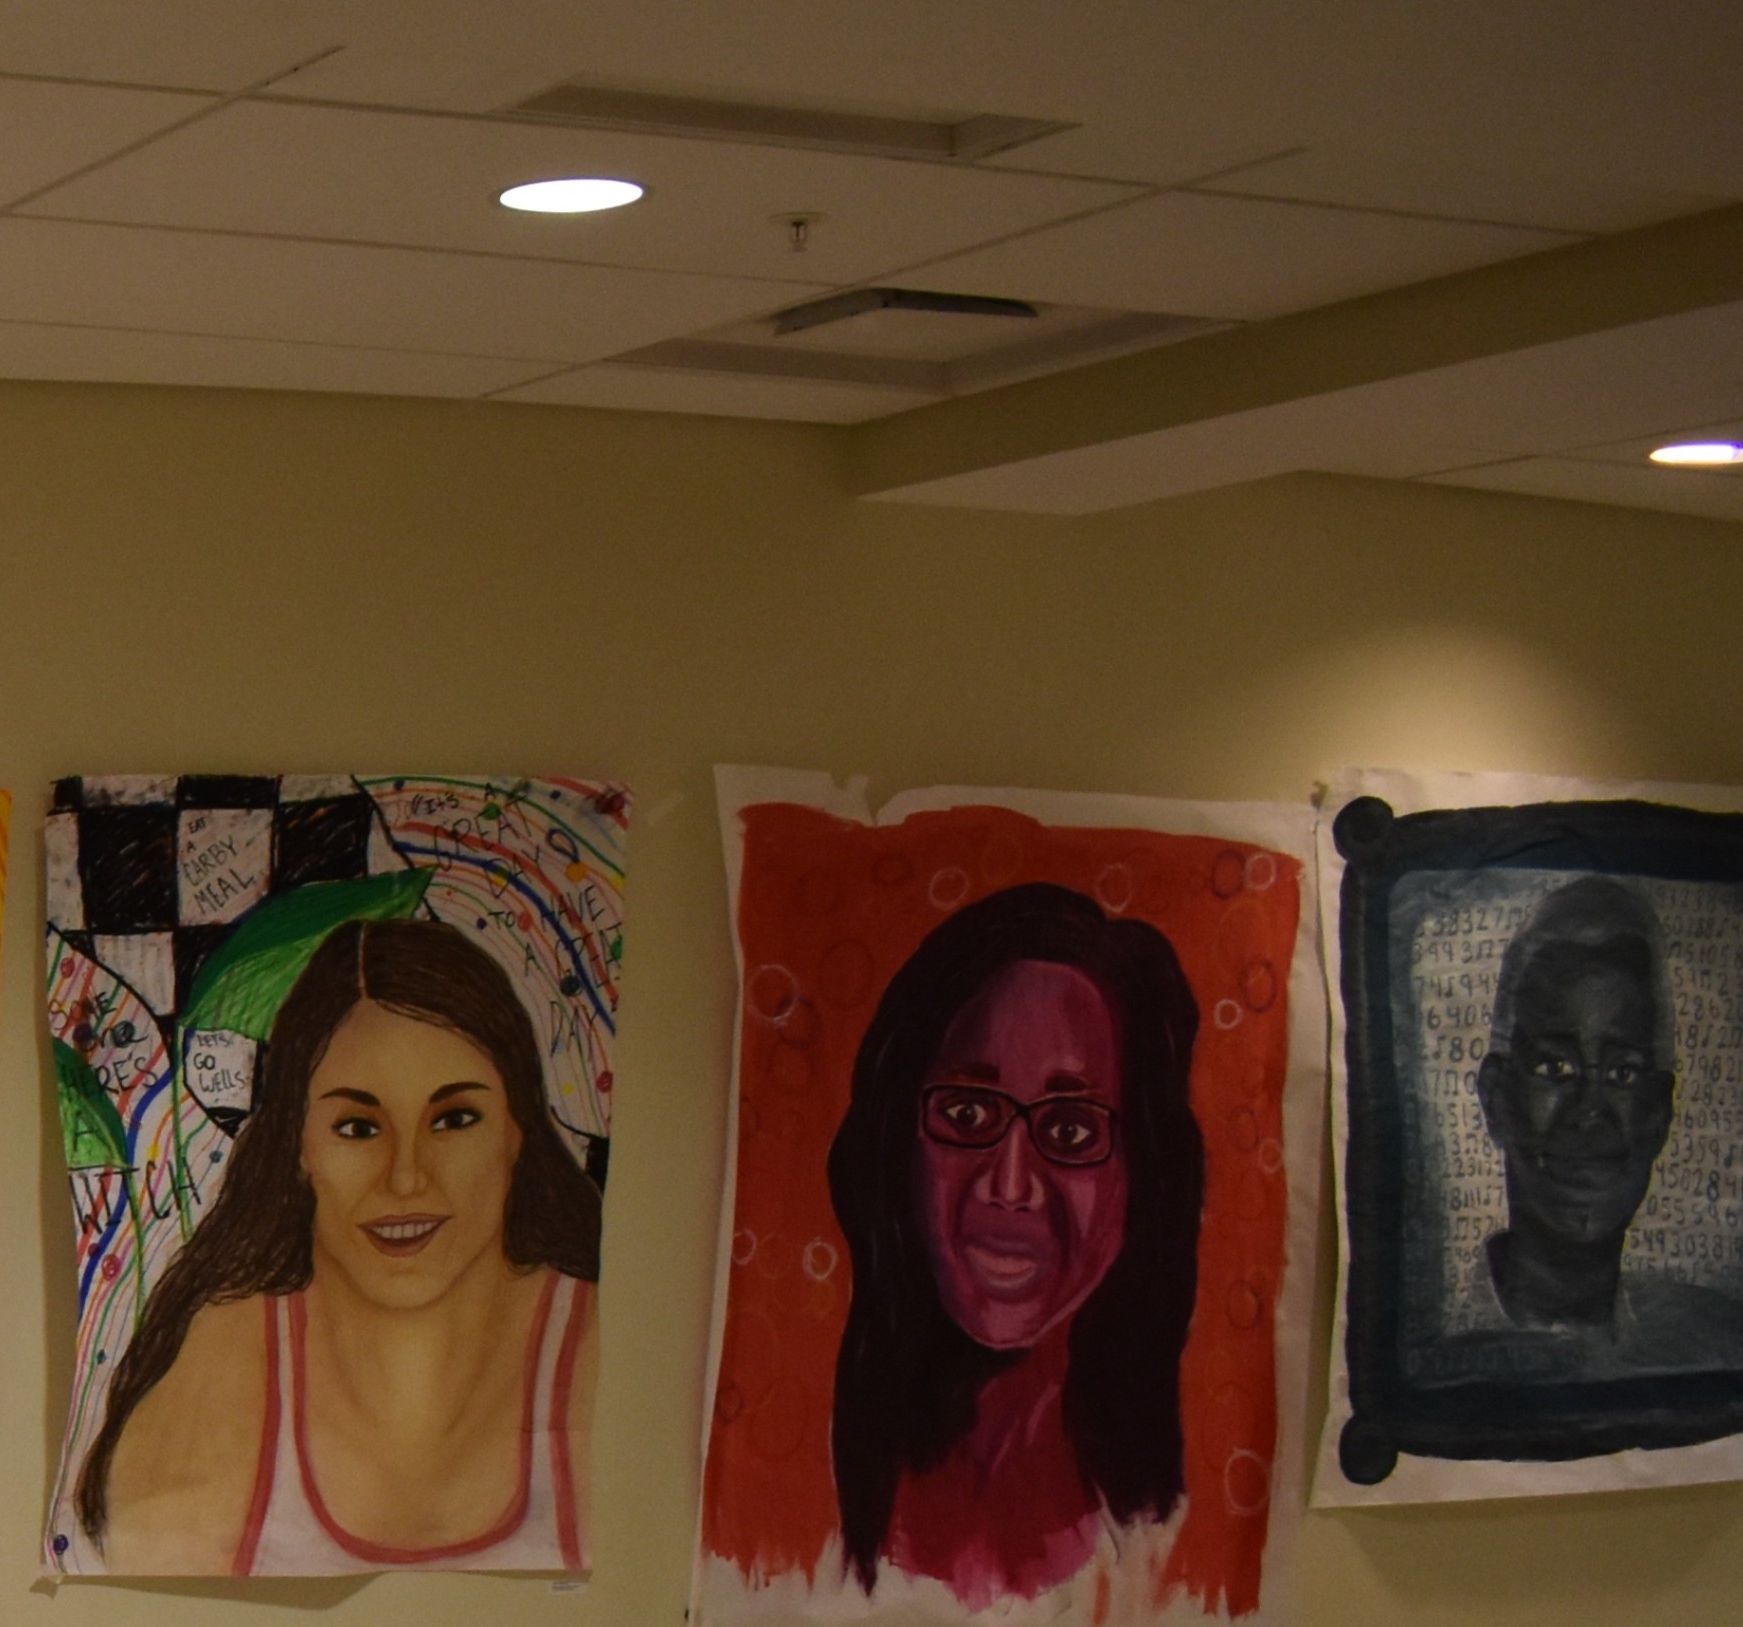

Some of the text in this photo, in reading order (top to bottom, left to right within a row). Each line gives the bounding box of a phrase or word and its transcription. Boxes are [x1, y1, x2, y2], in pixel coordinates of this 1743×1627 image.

[194, 868, 256, 916] MEAL
[193, 1052, 216, 1070] GO
[68, 1160, 202, 1234] WITCH
